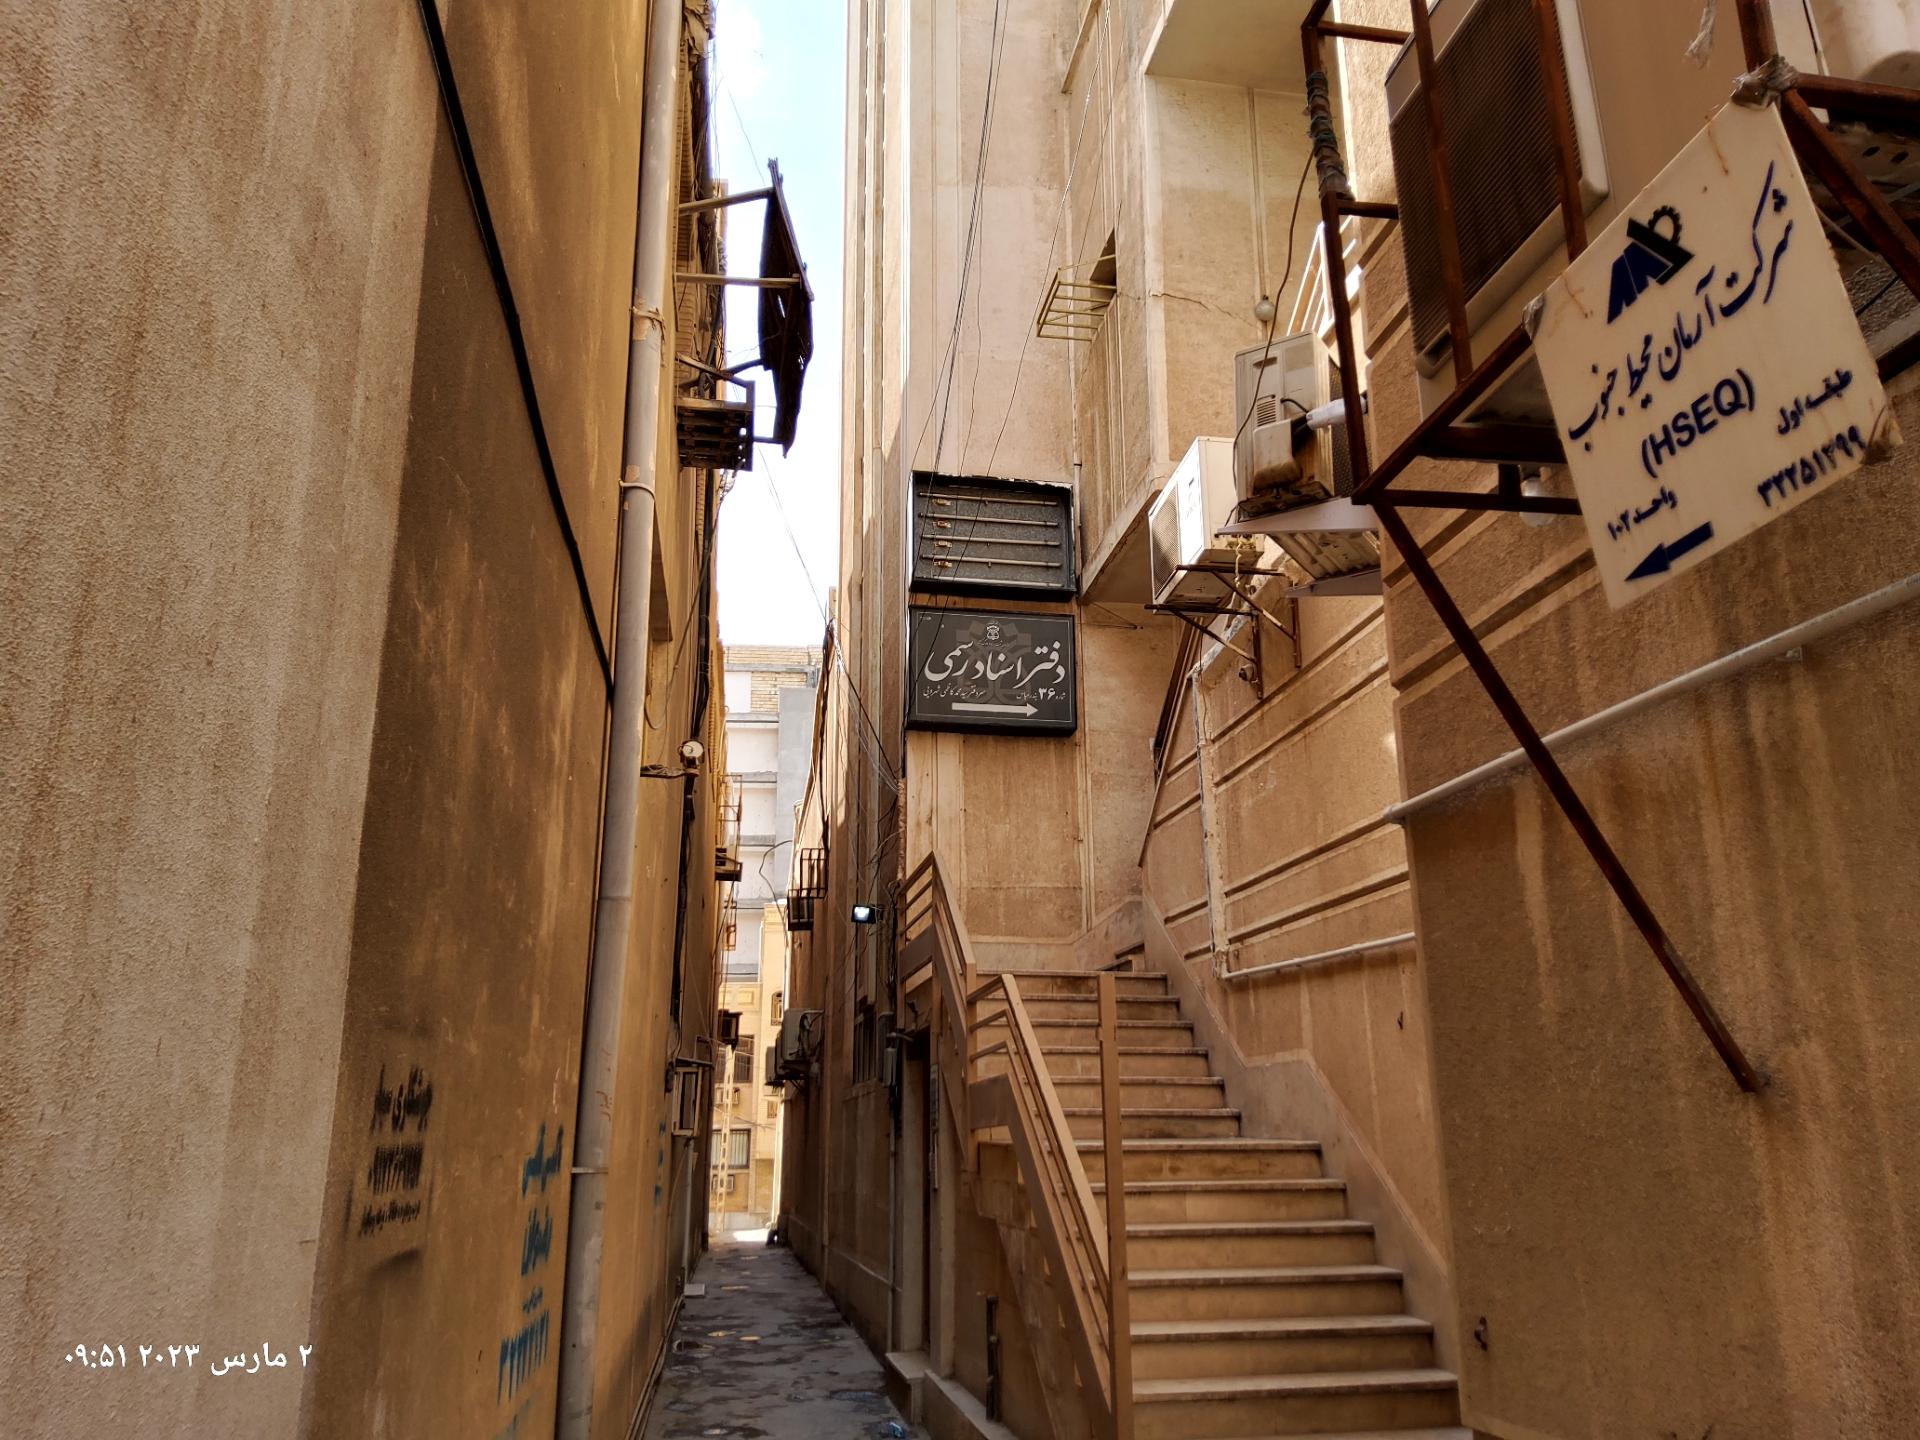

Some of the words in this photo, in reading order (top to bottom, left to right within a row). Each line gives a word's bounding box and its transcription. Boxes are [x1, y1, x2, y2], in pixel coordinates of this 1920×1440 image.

[1719, 160, 1793, 318] شرکت
[1658, 265, 1716, 381] آرمان
[1627, 333, 1653, 410] محیط
[1805, 369, 1853, 410] طبقه
[1568, 364, 1625, 452] جنوب
[1641, 367, 1756, 479] (HSEQ)
[1778, 396, 1805, 435] اول
[1633, 486, 1678, 524] واحد
[924, 640, 974, 682] رسمی
[971, 650, 1022, 681] اسناد
[1012, 640, 1066, 689] دفتر
[1038, 687, 1056, 701] ۳۶
